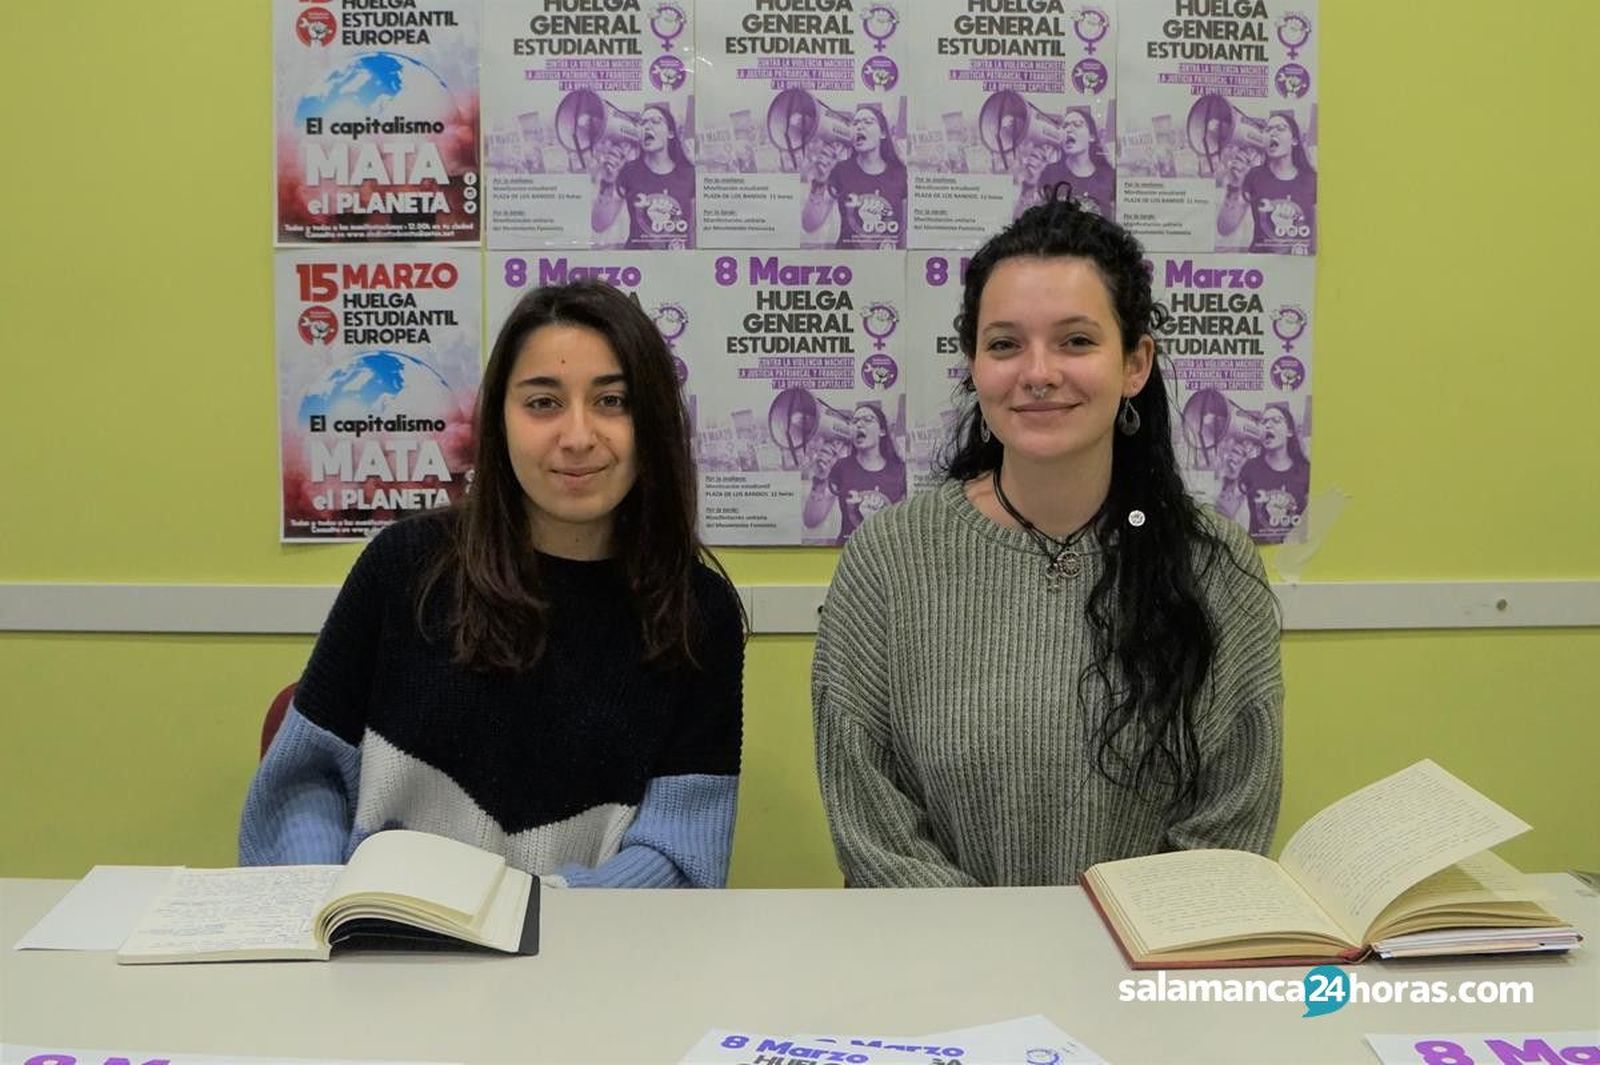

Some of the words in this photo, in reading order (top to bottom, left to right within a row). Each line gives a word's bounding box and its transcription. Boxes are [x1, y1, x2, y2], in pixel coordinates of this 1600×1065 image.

[967, 0, 1064, 13] HUELGA
[1175, 0, 1268, 19] HUELGA
[342, 11, 458, 27] ESTUDIANTIL
[530, 15, 641, 35] GENERAL
[742, 14, 854, 34] GENERAL
[954, 16, 1065, 36] GENERAL
[342, 29, 430, 45] EUROPEA
[1162, 20, 1269, 42] GENERAL
[513, 38, 642, 55] ESTUDIANTIL
[725, 37, 854, 54] ESTUDIANTIL
[937, 38, 1066, 56] ESTUDIANTIL
[1147, 42, 1269, 61] ESTUDIANTIL
[306, 117, 322, 135] El
[330, 116, 444, 140] capitalismo
[305, 141, 450, 186] MATA
[307, 192, 329, 215] el
[337, 192, 450, 214] PLANETA
[343, 263, 458, 289] MARZO
[505, 258, 527, 288] 8
[715, 256, 738, 286] 8
[750, 257, 852, 286] Marzo
[925, 256, 949, 286] 8
[1165, 260, 1264, 289] Marzo
[296, 263, 339, 302] 15
[343, 293, 417, 309] HUELGA
[757, 290, 853, 310] HUELGA
[1171, 293, 1263, 313] HUELGA
[343, 310, 458, 326] ESTUDIANTIL
[743, 313, 854, 333] GENERAL
[1160, 316, 1264, 335] GENERAL
[344, 328, 431, 345] EUROPEA
[727, 336, 854, 354] ESTUDIANTIL
[1156, 339, 1264, 355] TUDIANTIL
[310, 415, 327, 433] El
[333, 415, 446, 437] capitalismo
[308, 439, 452, 482] MATA
[313, 489, 335, 510] el
[341, 488, 452, 510] PLANETA
[721, 1035, 750, 1049] 8
[756, 1039, 869, 1062] Marzo
[1414, 1040, 1475, 1065] 8
